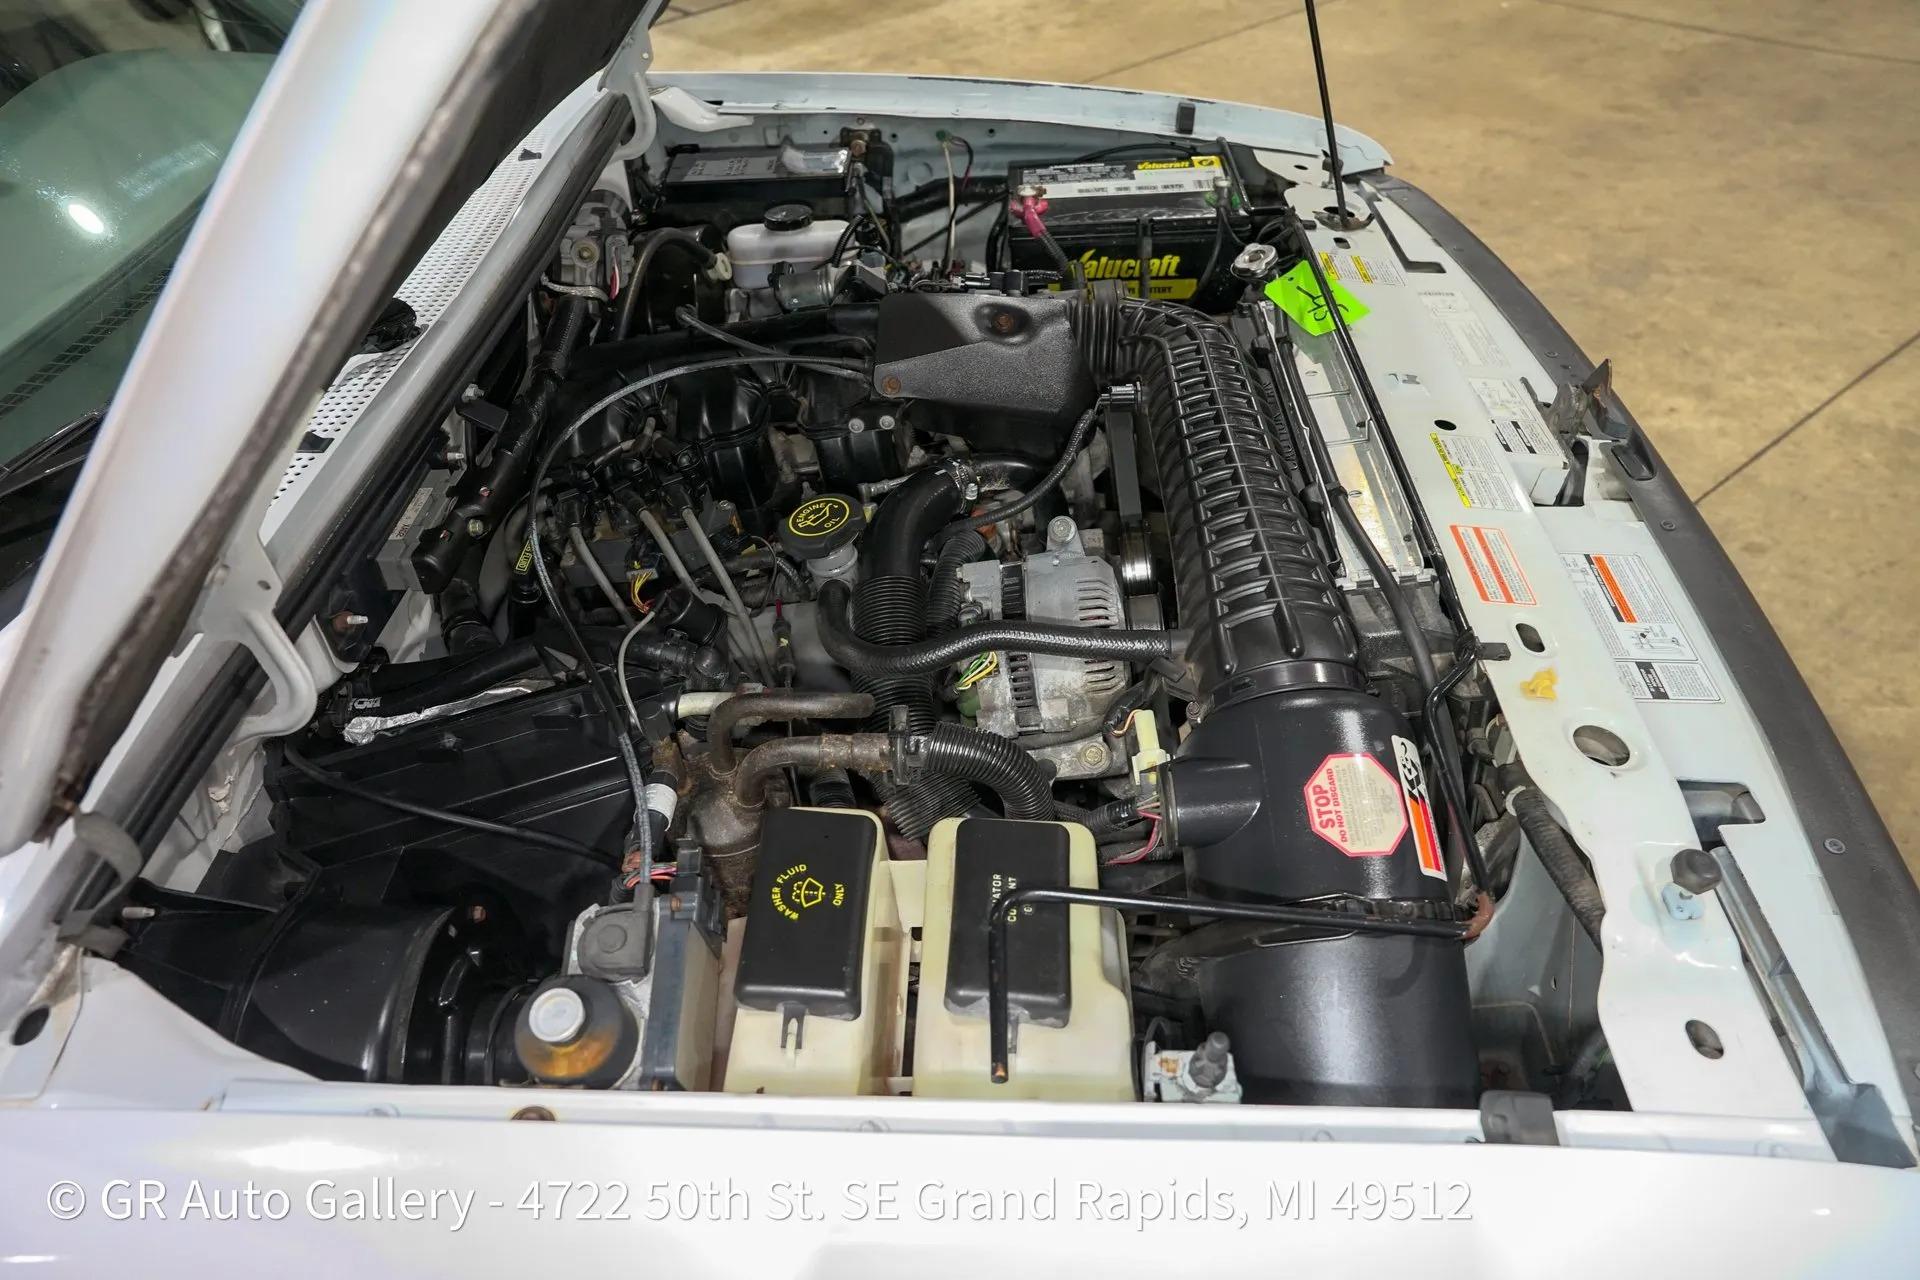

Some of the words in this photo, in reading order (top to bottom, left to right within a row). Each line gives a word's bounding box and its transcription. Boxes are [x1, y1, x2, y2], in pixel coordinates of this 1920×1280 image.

[797, 502, 826, 523] ENGINE
[824, 517, 840, 528] OIL
[1326, 768, 1341, 808] DISCARD
[1312, 784, 1335, 829] STOP
[1335, 809, 1345, 828] NOT
[1340, 829, 1348, 843] DO
[776, 864, 807, 884] FLUID
[771, 887, 799, 920] WASHER
[832, 883, 845, 906] ONLY
